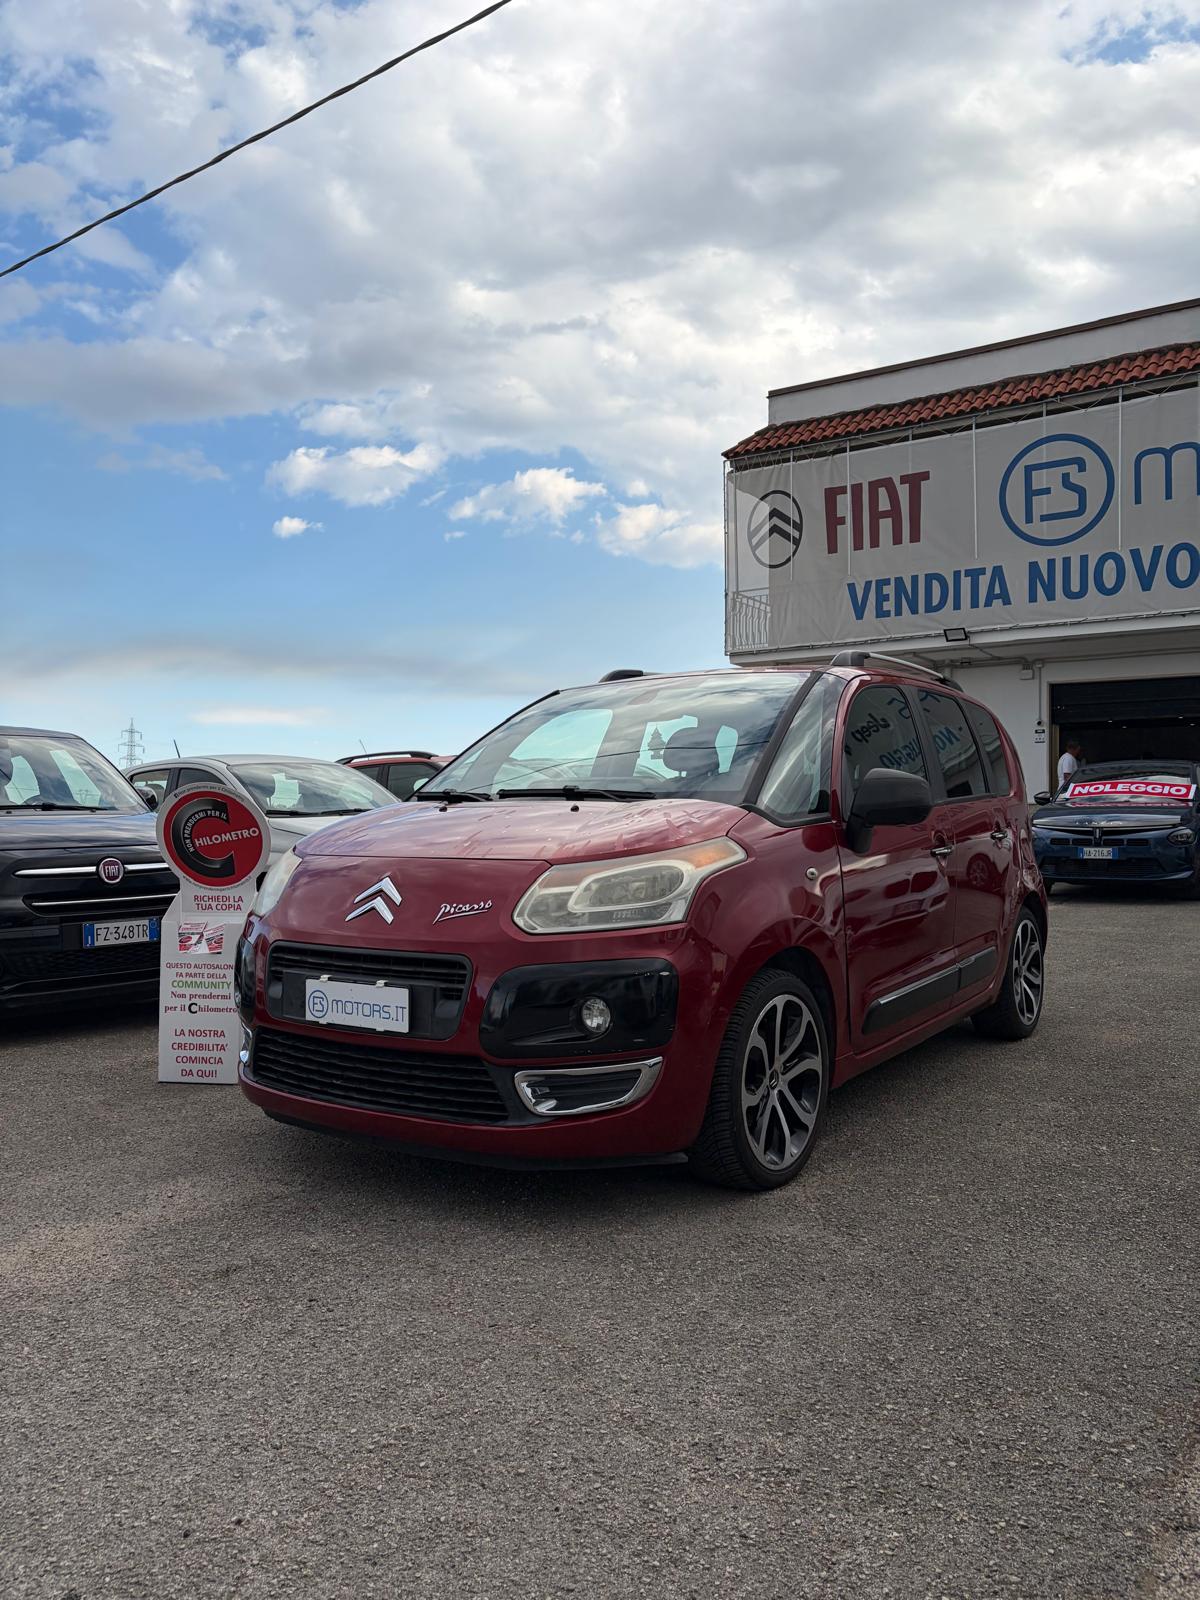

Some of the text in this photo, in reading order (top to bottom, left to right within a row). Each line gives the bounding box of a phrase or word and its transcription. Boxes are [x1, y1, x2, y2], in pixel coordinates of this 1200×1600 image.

[824, 470, 930, 554] FIAT
[847, 542, 1200, 621] VENDITA NUOVO
[1073, 783, 1187, 795] NOLEGGIO
[184, 811, 206, 838] PRENDERMI
[185, 840, 195, 852] NON
[104, 865, 120, 878] FIAT
[193, 895, 244, 903] RICHIEDI LA
[195, 903, 242, 911] TUA COPIA
[165, 962, 234, 971] QUESTO AUTOSALON
[171, 980, 232, 989] COMMUNITY
[170, 991, 231, 1000] Non prendermi
[164, 1002, 237, 1014] per il Chilometro
[174, 1029, 226, 1038] LA NOSTRA
[175, 1055, 224, 1065] COMINCIA
[181, 1069, 217, 1078] DA QUI!
